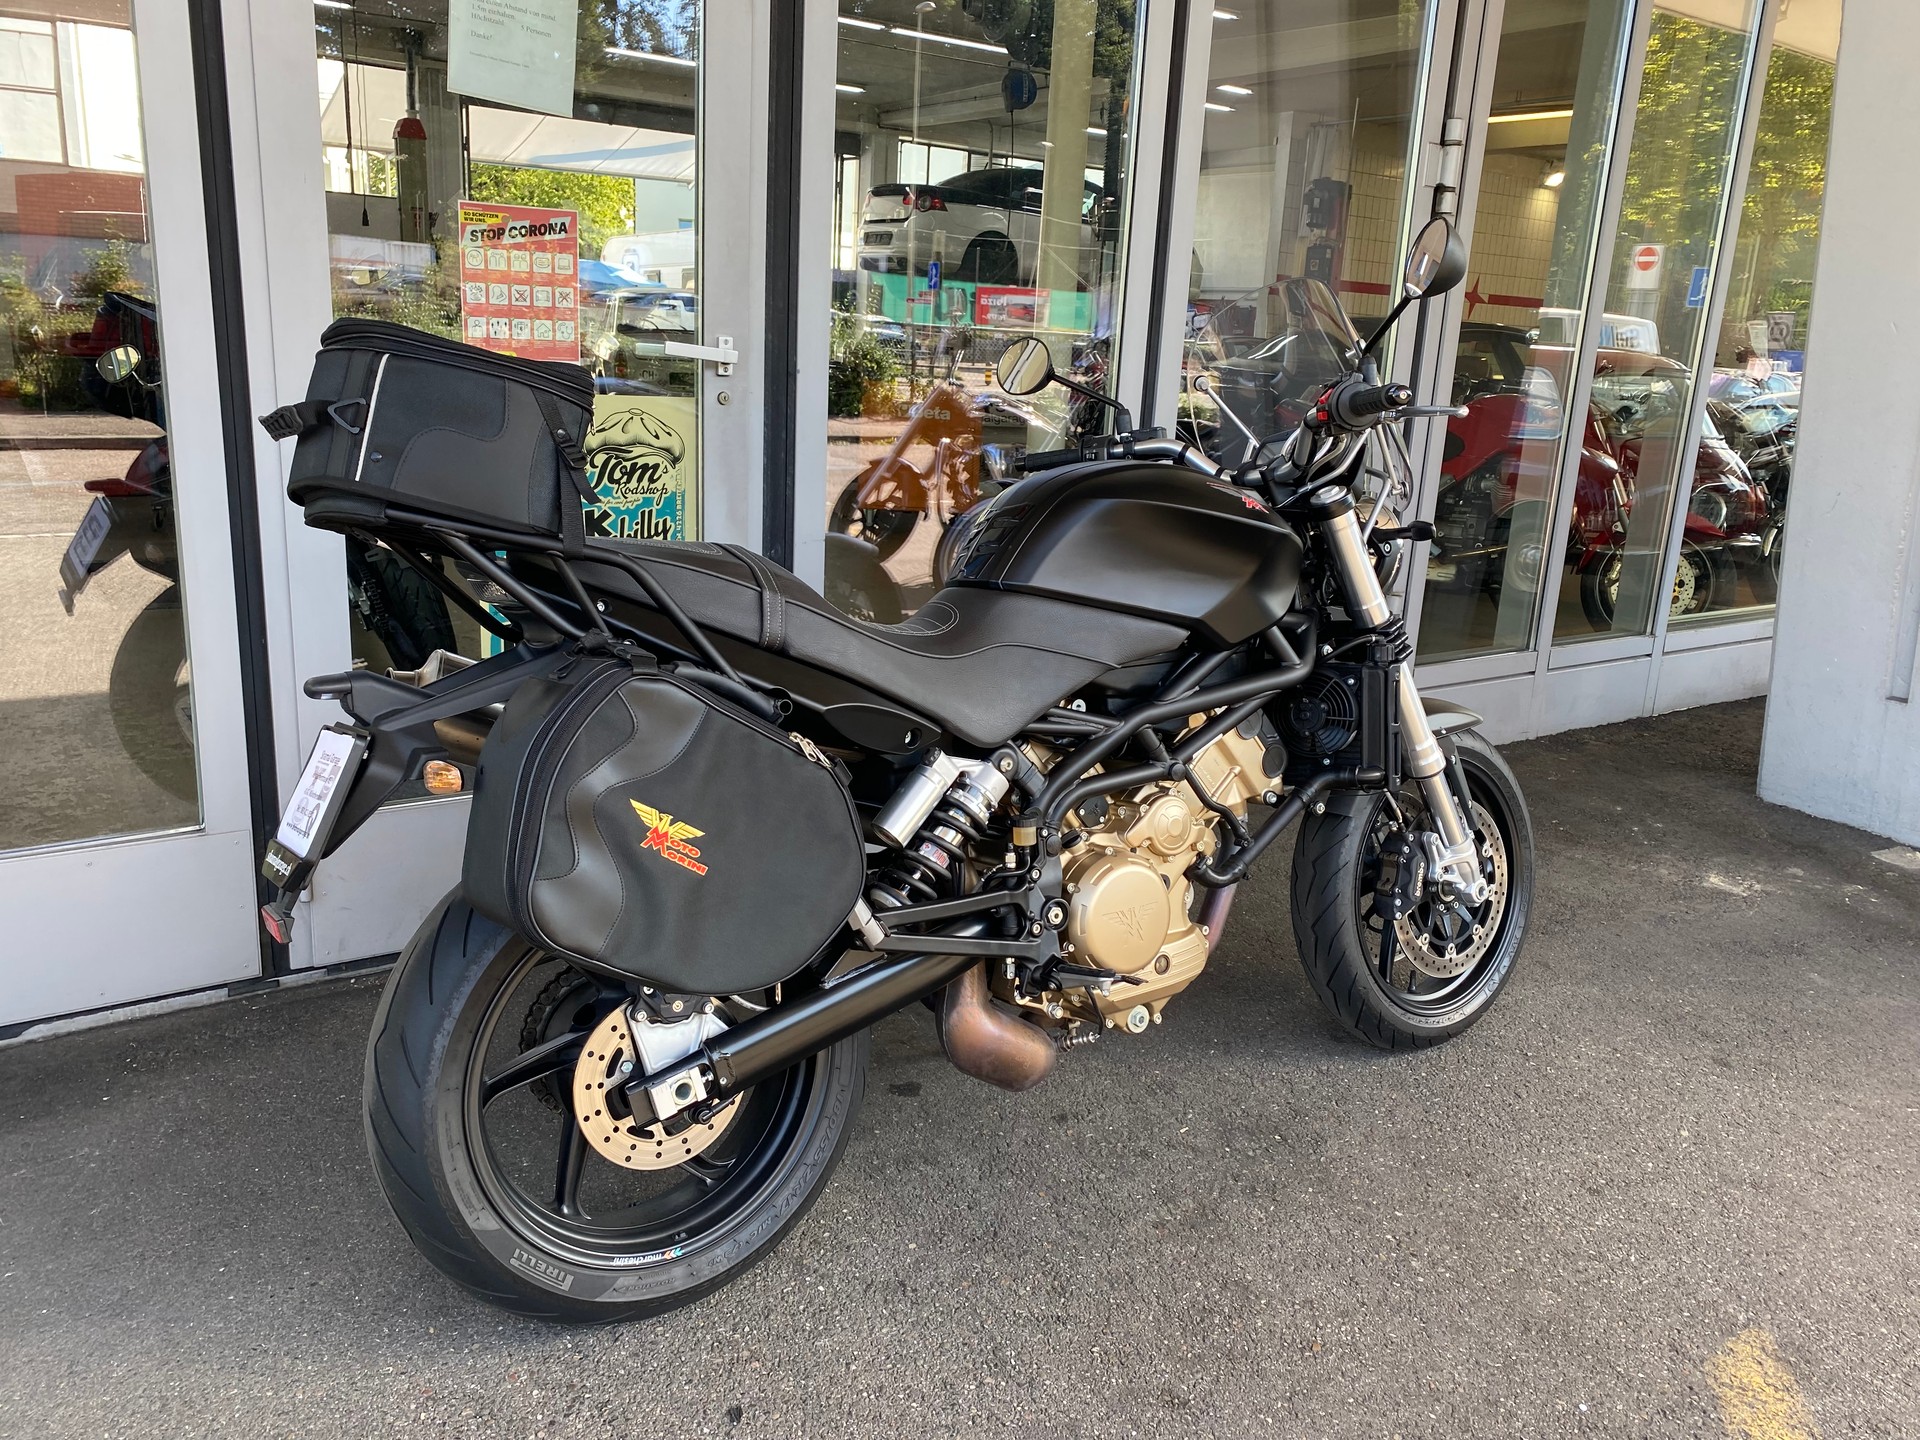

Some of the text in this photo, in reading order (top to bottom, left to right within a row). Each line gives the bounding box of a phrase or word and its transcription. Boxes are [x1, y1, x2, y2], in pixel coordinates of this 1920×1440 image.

[504, 2, 528, 14] Abstand
[529, 9, 540, 17] von
[526, 25, 552, 38] Personen
[472, 211, 499, 219] SCHÜTZEN
[469, 221, 569, 243] STOP CORONA
[589, 446, 669, 491] Tom's
[615, 480, 670, 507] Rodshop
[640, 833, 709, 876] MORINI
[646, 825, 701, 858] MOTO
[1414, 861, 1425, 897] brembo
[508, 1247, 575, 1292] PIRELLI
[610, 1252, 664, 1267] marchesini
